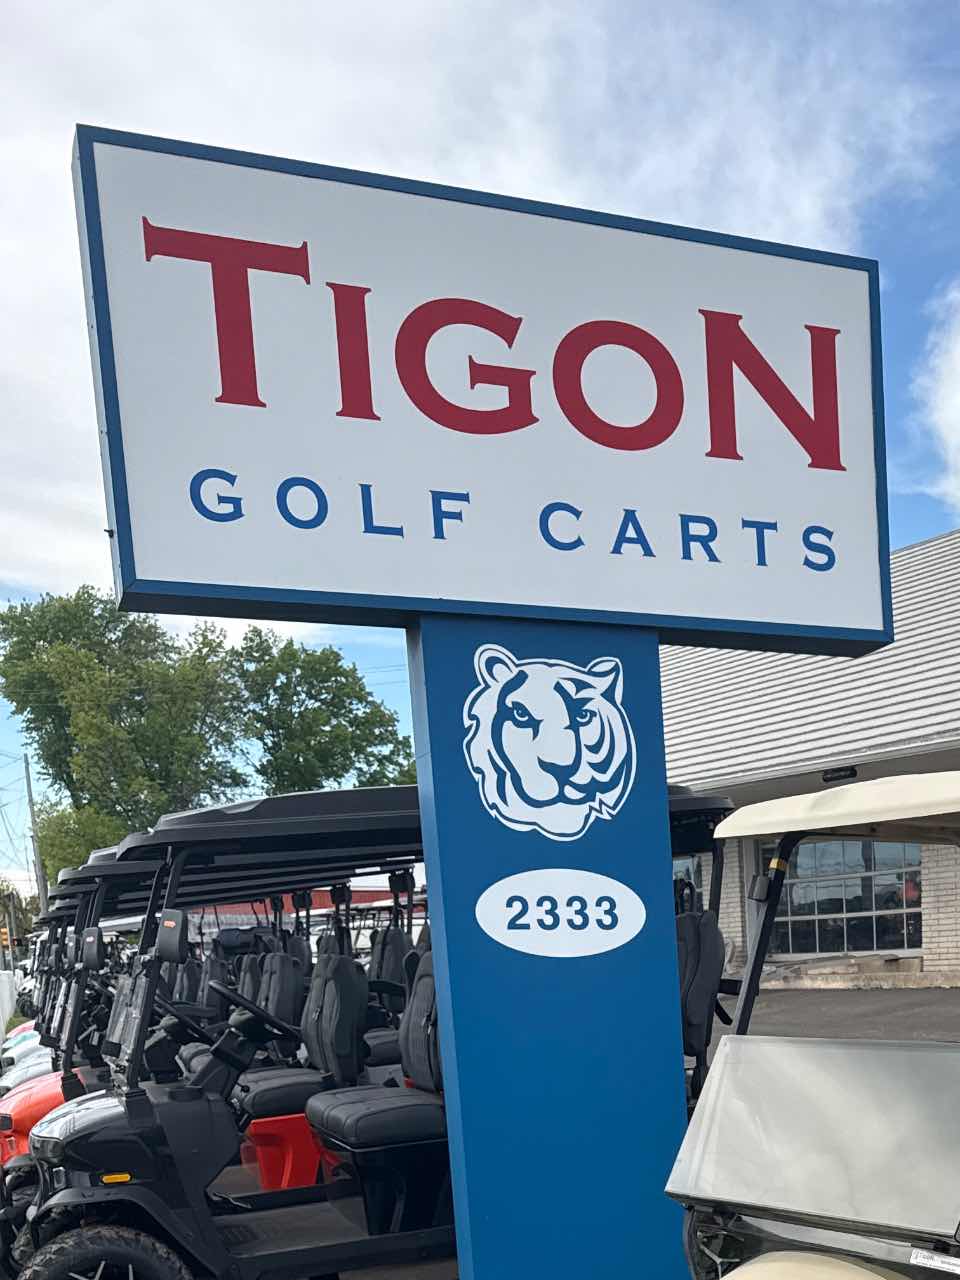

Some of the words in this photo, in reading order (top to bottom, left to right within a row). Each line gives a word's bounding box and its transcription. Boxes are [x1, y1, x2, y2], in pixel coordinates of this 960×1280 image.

[142, 216, 847, 472] TIGON
[188, 467, 472, 542] GOLF
[538, 500, 839, 574] CARTS
[505, 895, 619, 931] 2333
